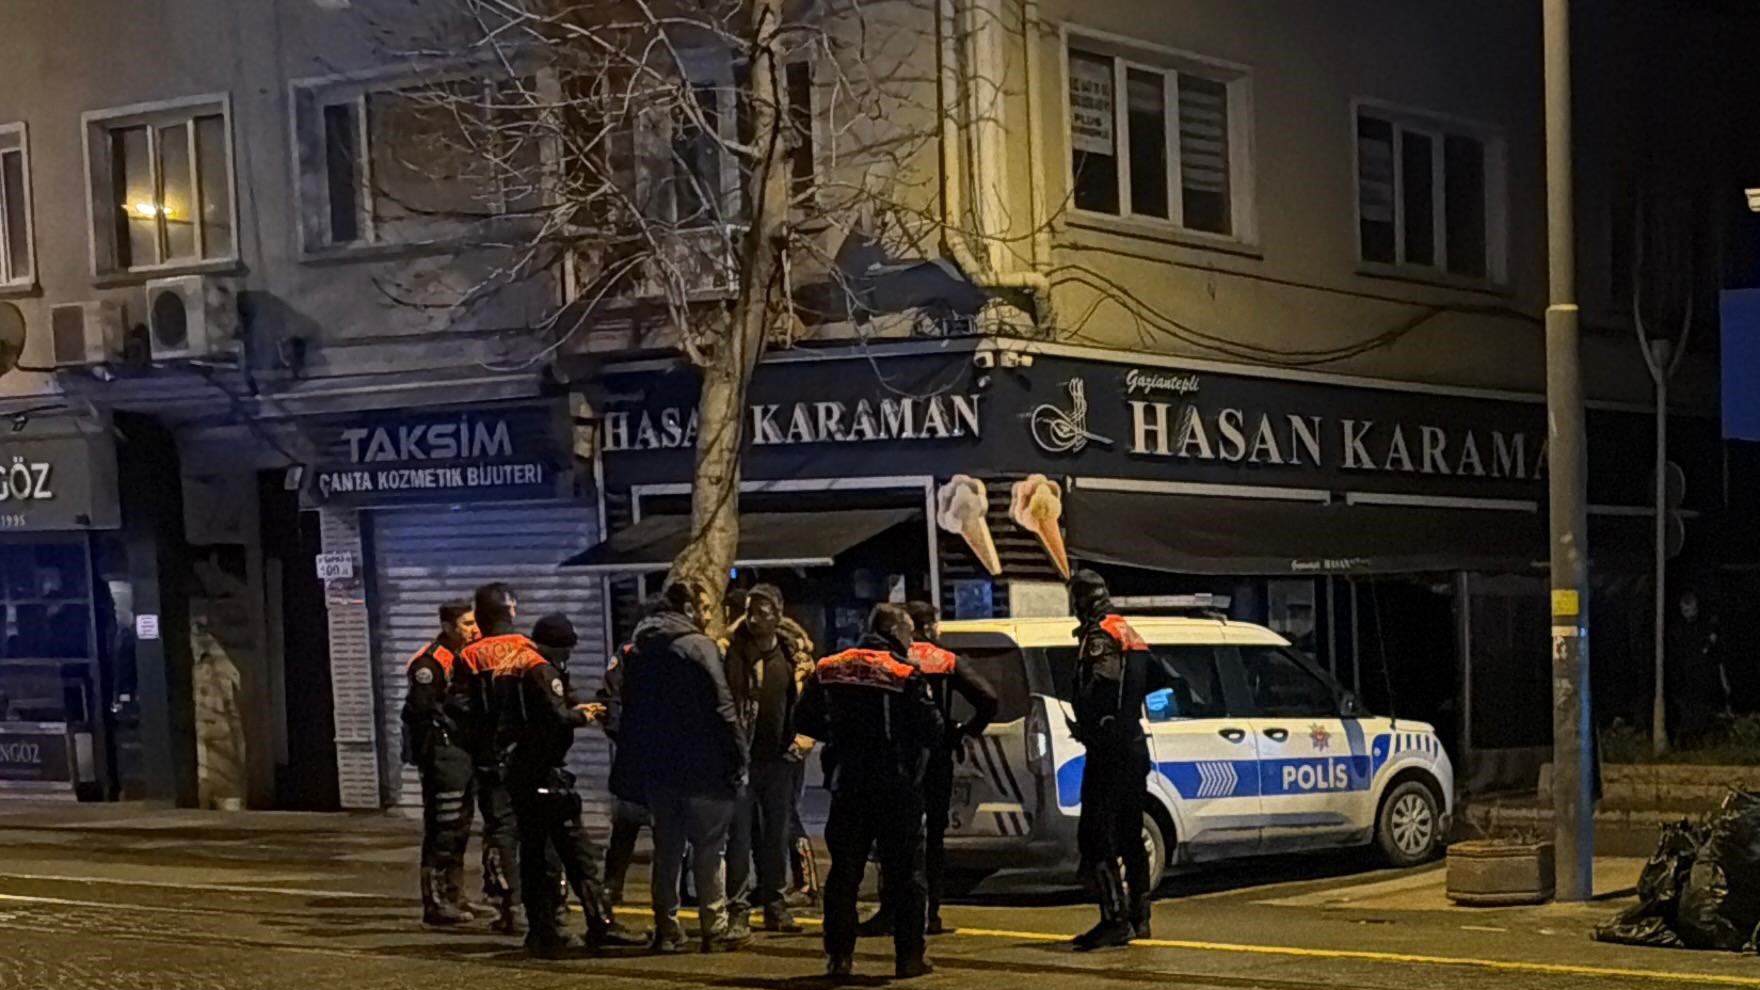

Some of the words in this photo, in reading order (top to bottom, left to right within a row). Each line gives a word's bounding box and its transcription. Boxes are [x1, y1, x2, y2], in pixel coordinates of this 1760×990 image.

[1126, 369, 1200, 394] Gaziantepli
[341, 413, 513, 463] TAKSİM
[601, 405, 698, 451] HASA
[750, 394, 980, 446] KARAMAN
[1128, 400, 1323, 466] HASAN
[1341, 418, 1548, 480] KARAM
[319, 471, 373, 498] ÇANTA
[1282, 757, 1348, 790] POLİS
